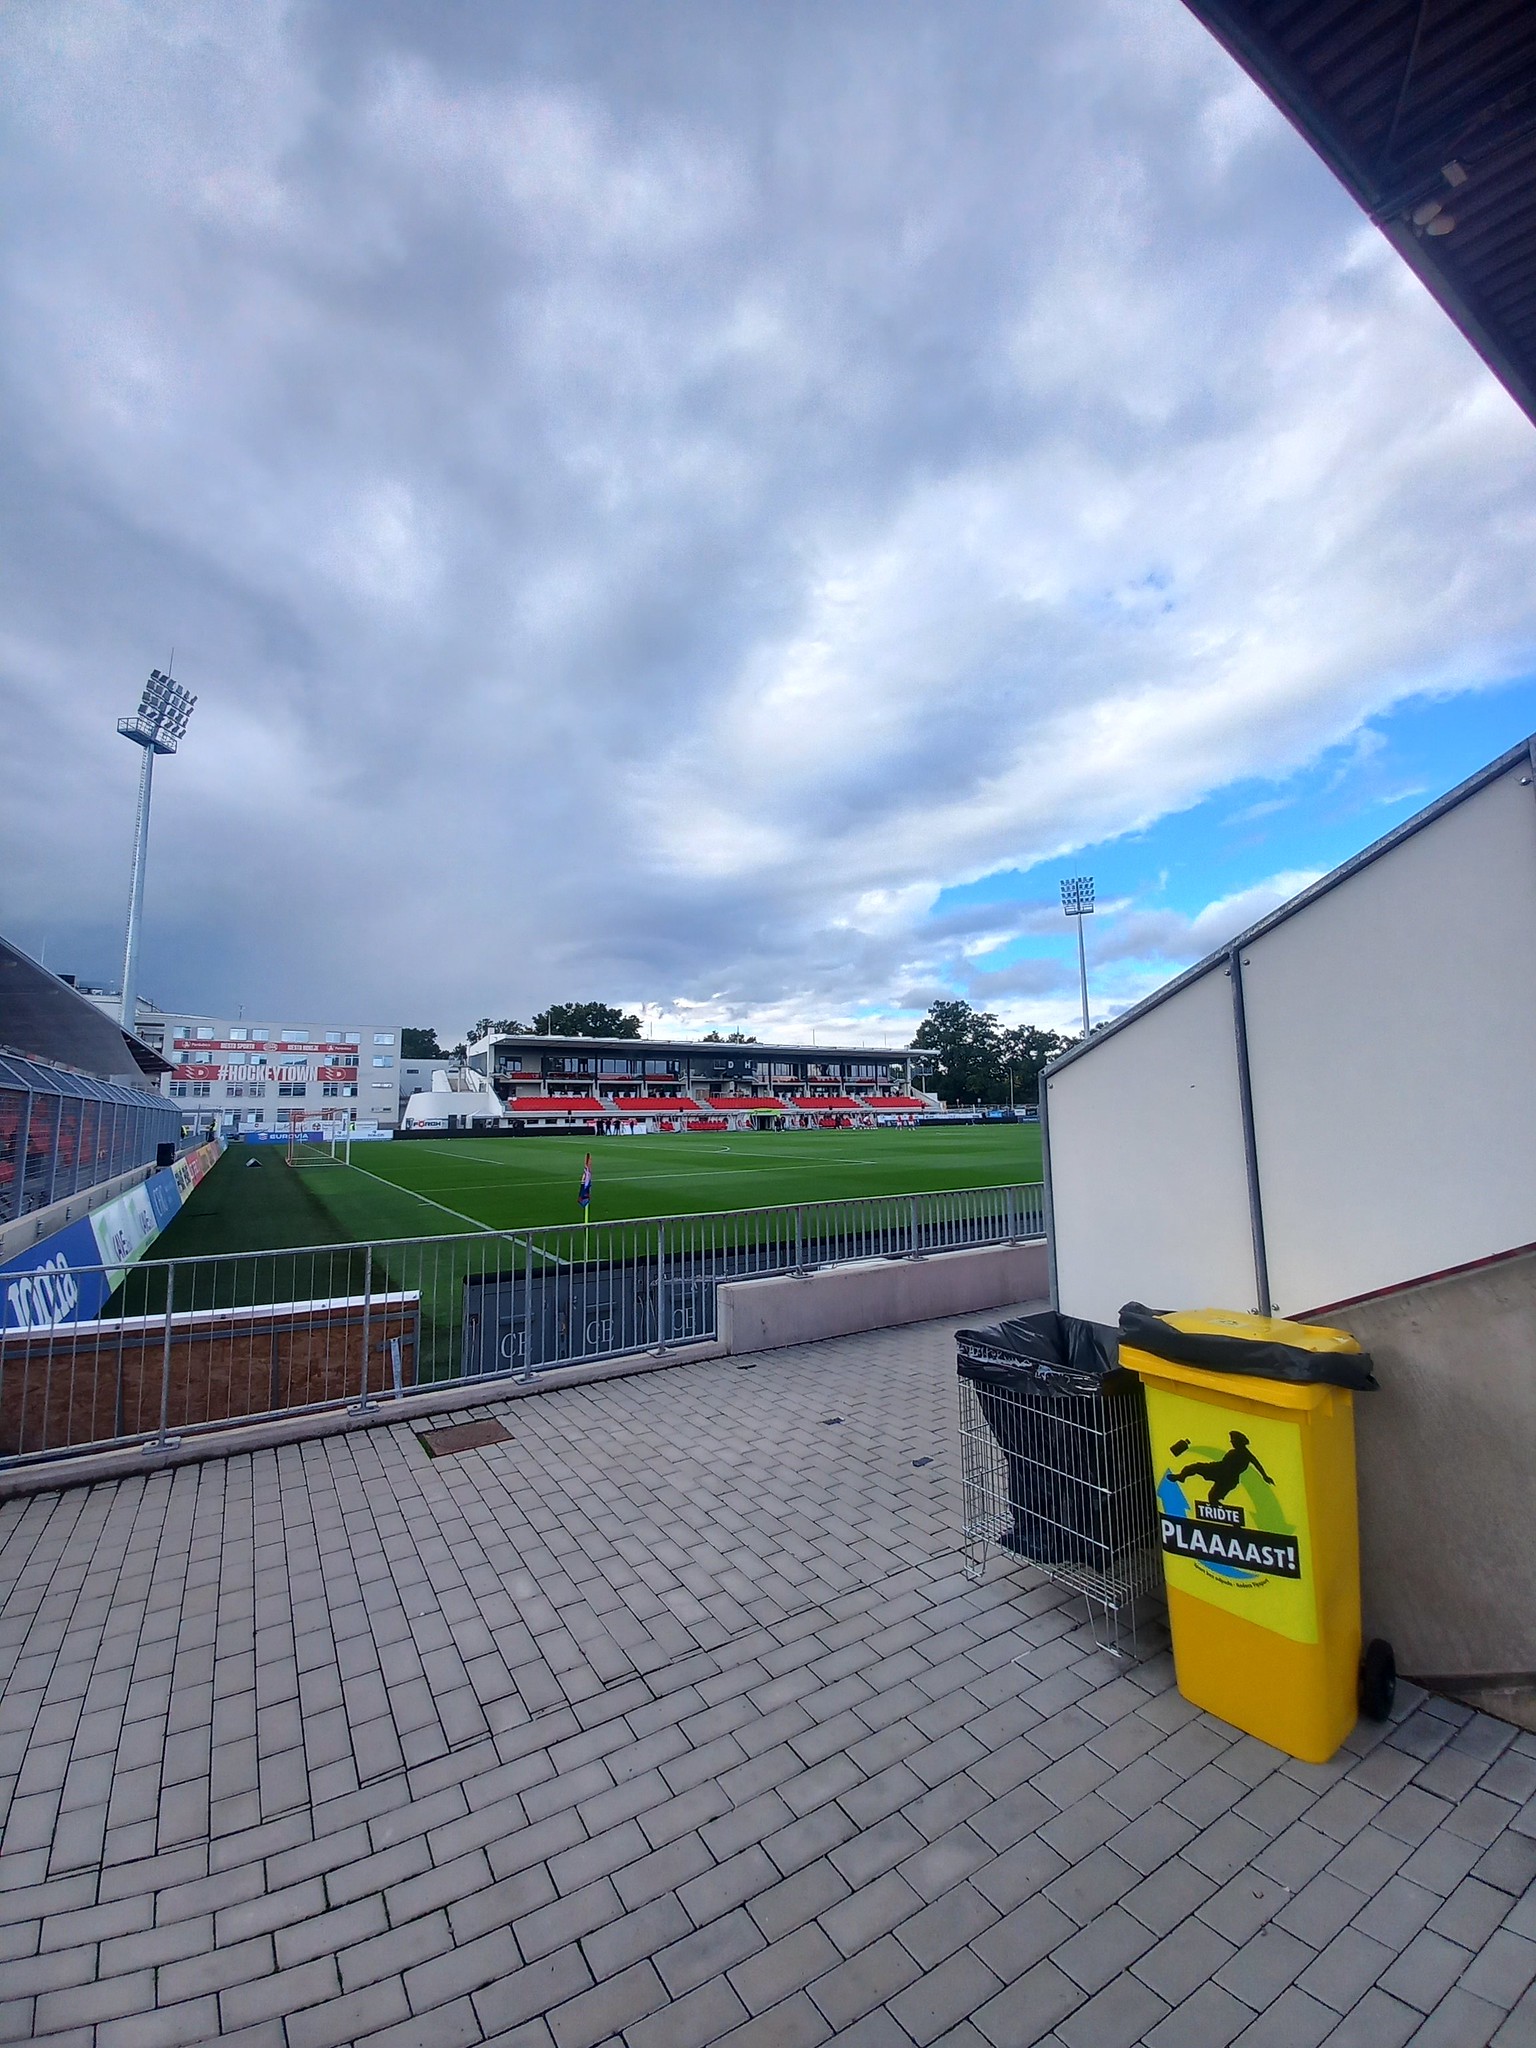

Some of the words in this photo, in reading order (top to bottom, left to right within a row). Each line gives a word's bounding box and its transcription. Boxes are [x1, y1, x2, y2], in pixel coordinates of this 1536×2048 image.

[217, 1065, 319, 1082] #HOCKEYTOWN
[1197, 1503, 1241, 1524] TŘIĎTE
[1161, 1519, 1297, 1571] PLAAAAST!
